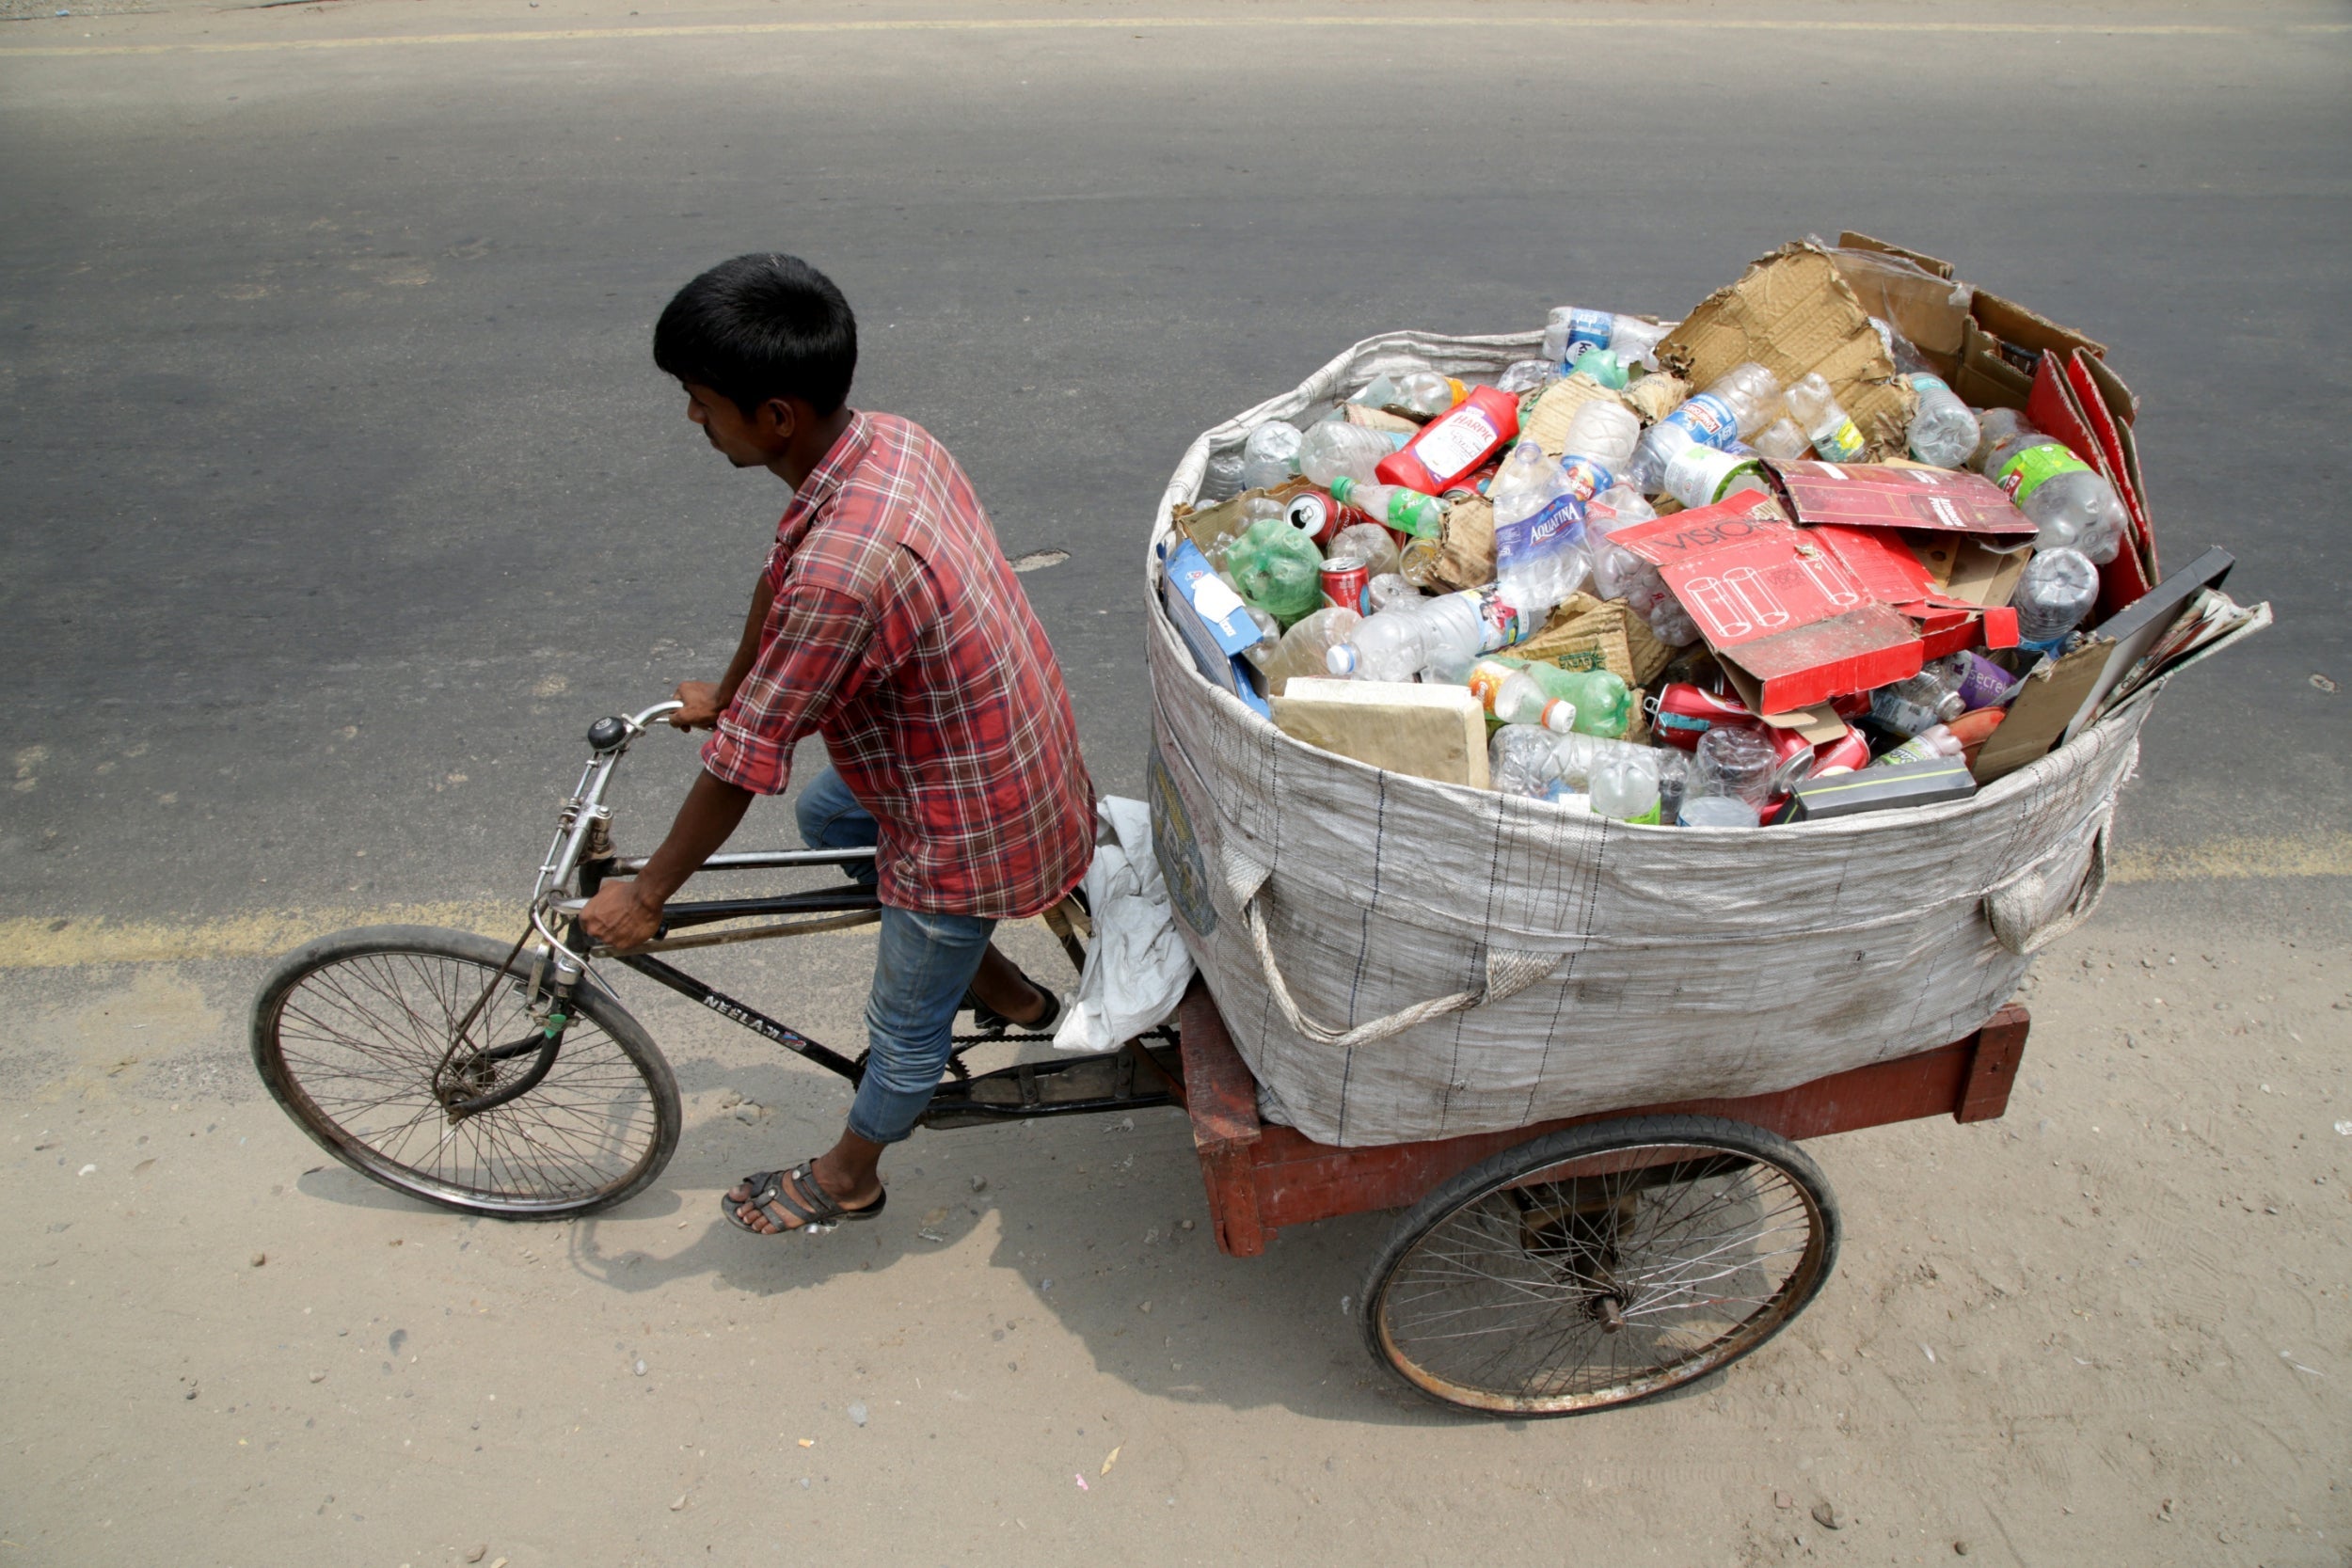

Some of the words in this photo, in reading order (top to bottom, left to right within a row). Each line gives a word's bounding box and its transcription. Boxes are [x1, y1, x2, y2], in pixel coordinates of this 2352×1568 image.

[1453, 415, 1494, 443] HARPIC
[1531, 502, 1581, 546] AQUAFINA
[703, 995, 781, 1039] NEELAM
